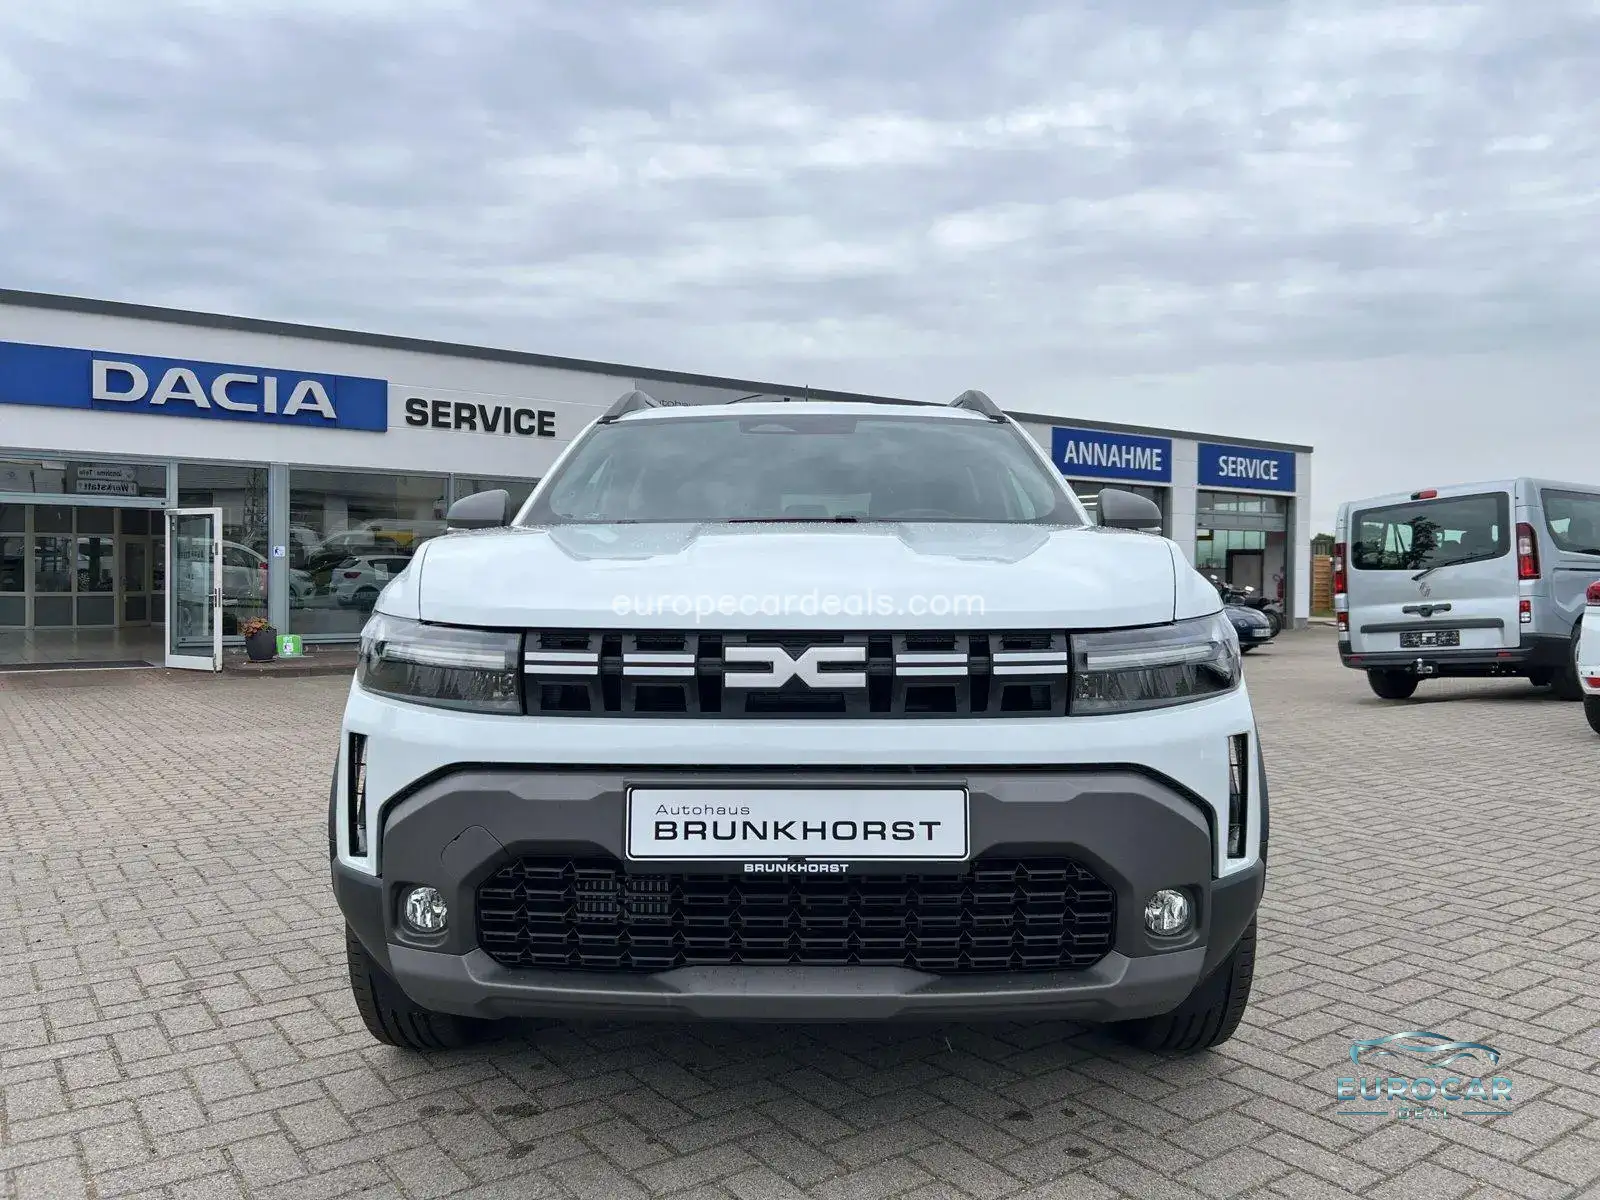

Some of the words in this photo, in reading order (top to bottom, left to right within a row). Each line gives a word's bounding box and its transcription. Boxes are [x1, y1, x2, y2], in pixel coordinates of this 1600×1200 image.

[92, 359, 337, 418] DACIA
[405, 398, 556, 437] SERVICE
[1064, 440, 1162, 471] ANNAHME
[1218, 455, 1278, 481] SERVICE
[655, 804, 751, 816] Autohaus
[654, 820, 941, 841] BRUNKHORST
[743, 863, 849, 873] BRUNKHORST
